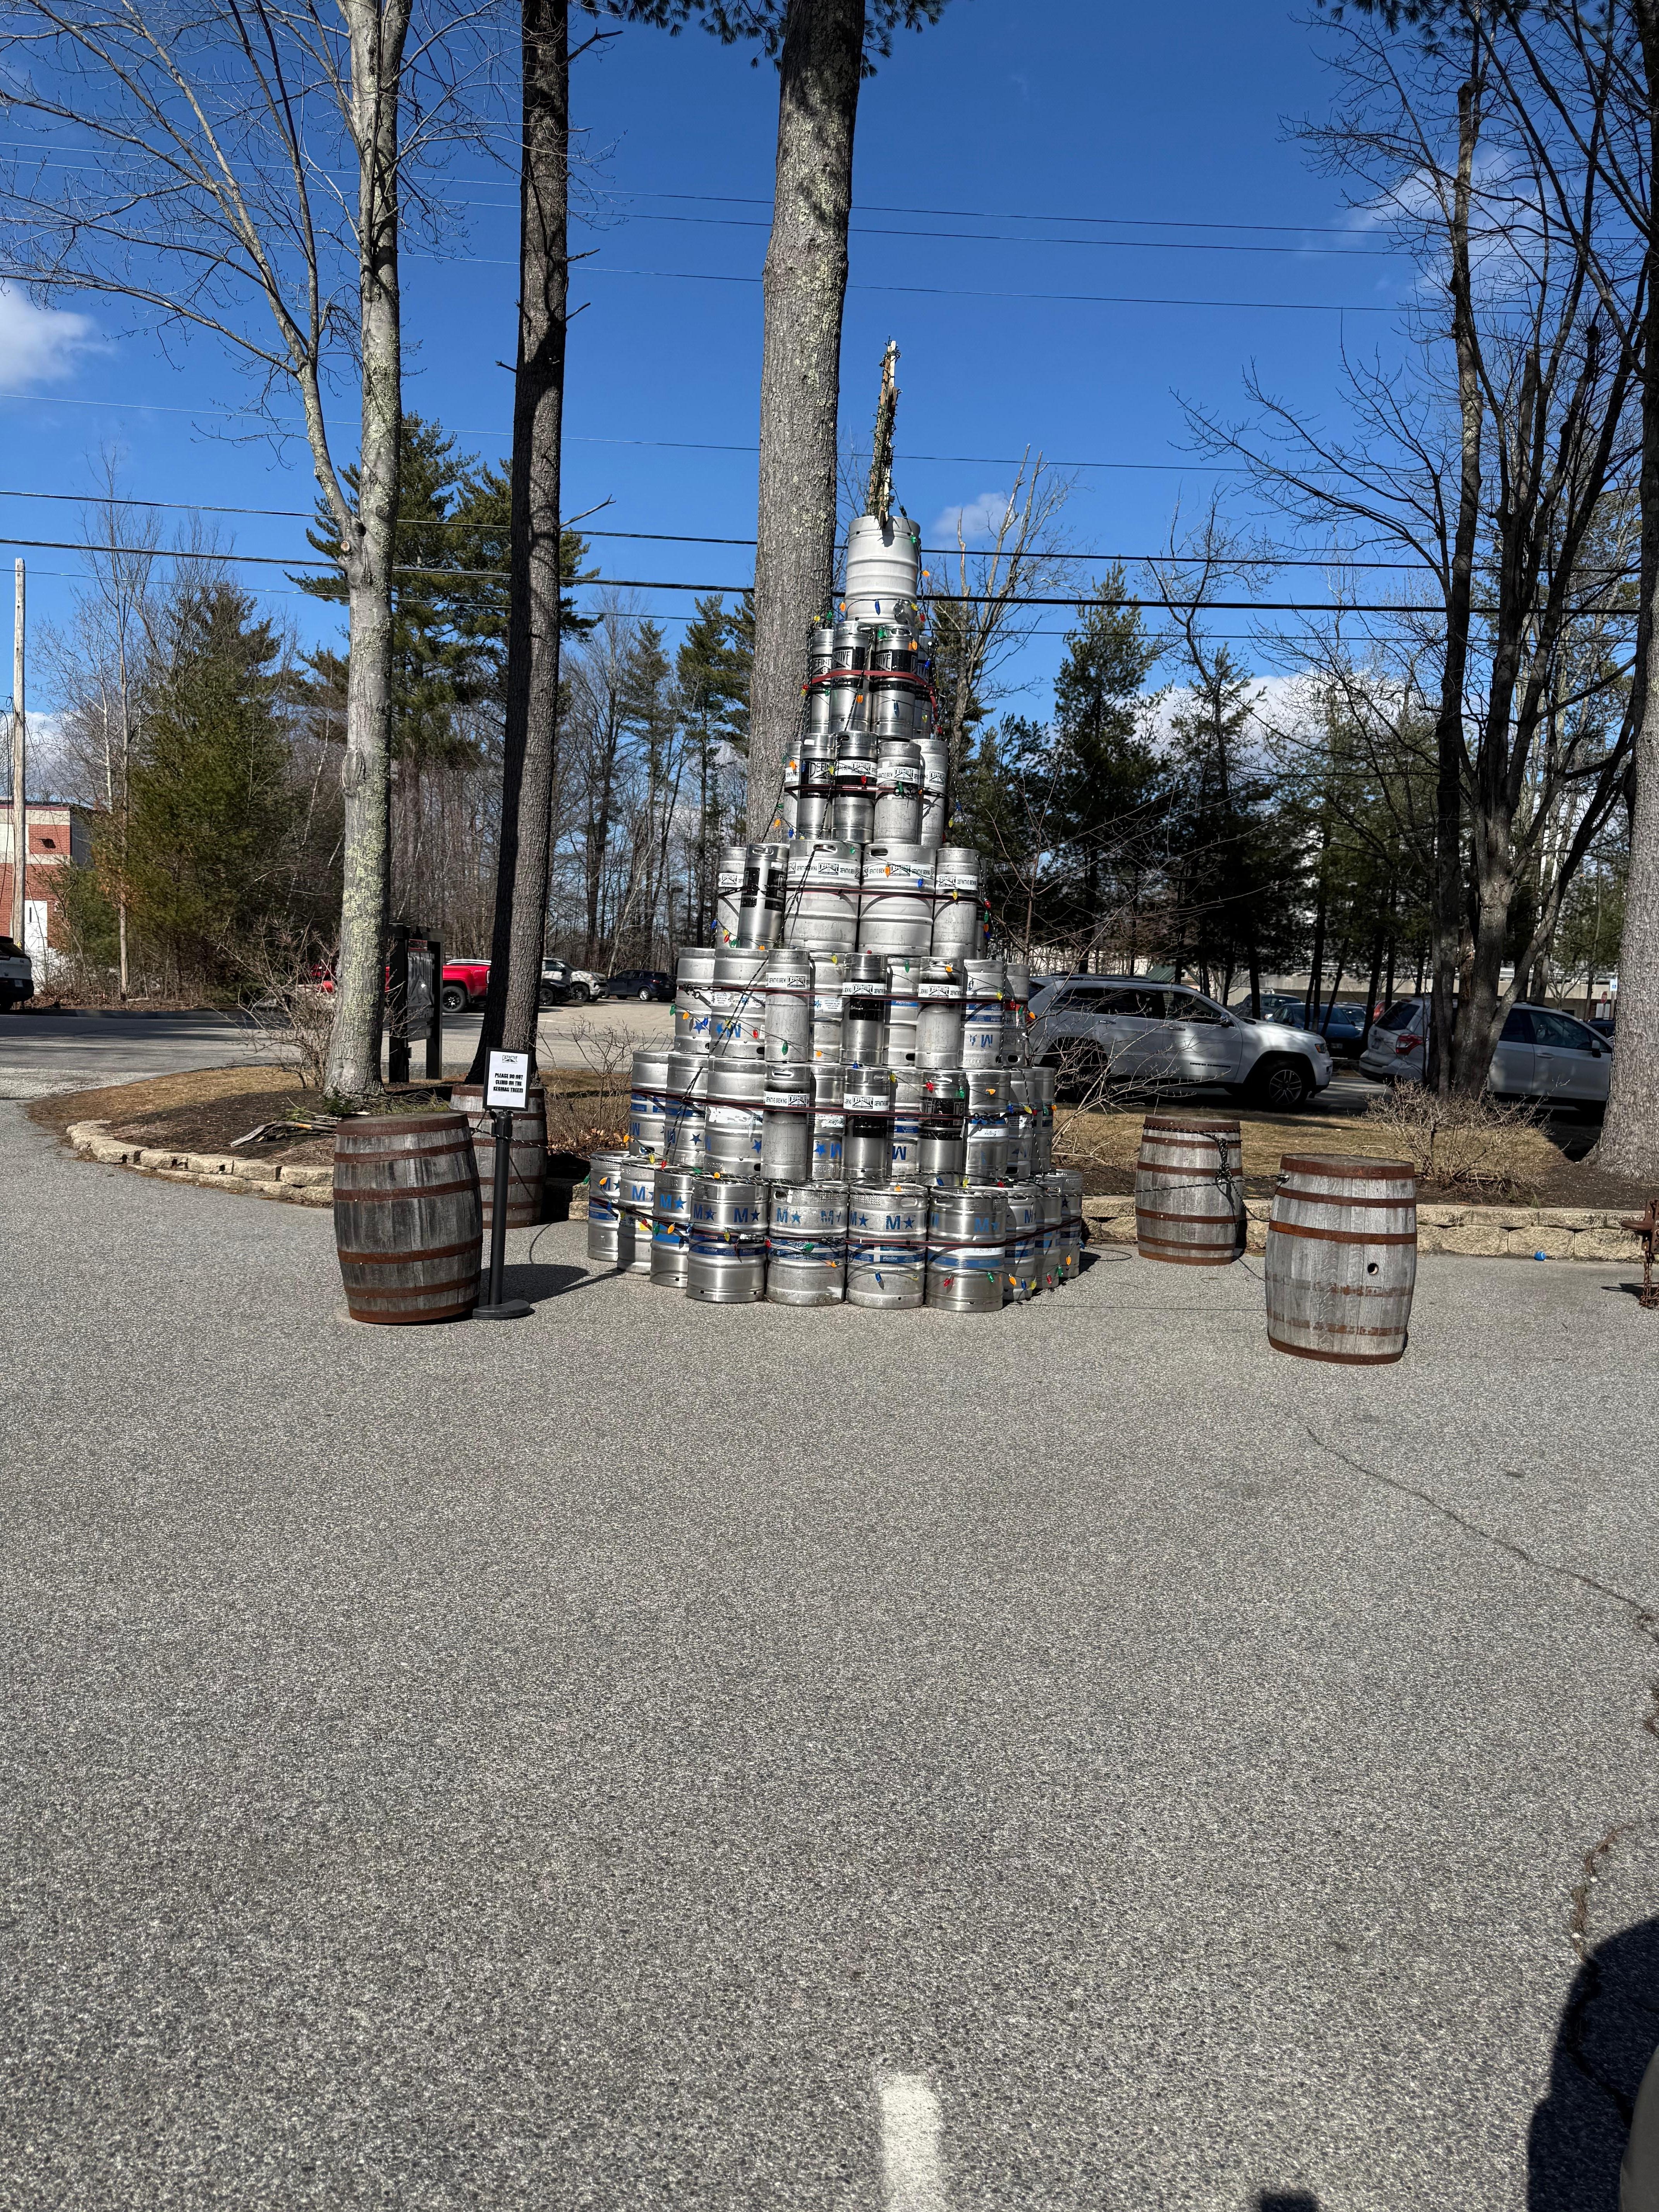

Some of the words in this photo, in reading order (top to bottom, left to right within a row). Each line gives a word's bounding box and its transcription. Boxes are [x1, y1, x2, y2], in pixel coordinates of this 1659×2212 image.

[812, 658, 831, 673] DEFINIT
[810, 762, 829, 778] DEFIN
[632, 1185, 646, 1201] M
[660, 1194, 672, 1209] M
[694, 1204, 703, 1220] M
[734, 1208, 748, 1223] M
[776, 1207, 788, 1223] M
[821, 1211, 834, 1225] M
[850, 1211, 857, 1226] M
[886, 1215, 901, 1230] M
[974, 1217, 989, 1233] M
